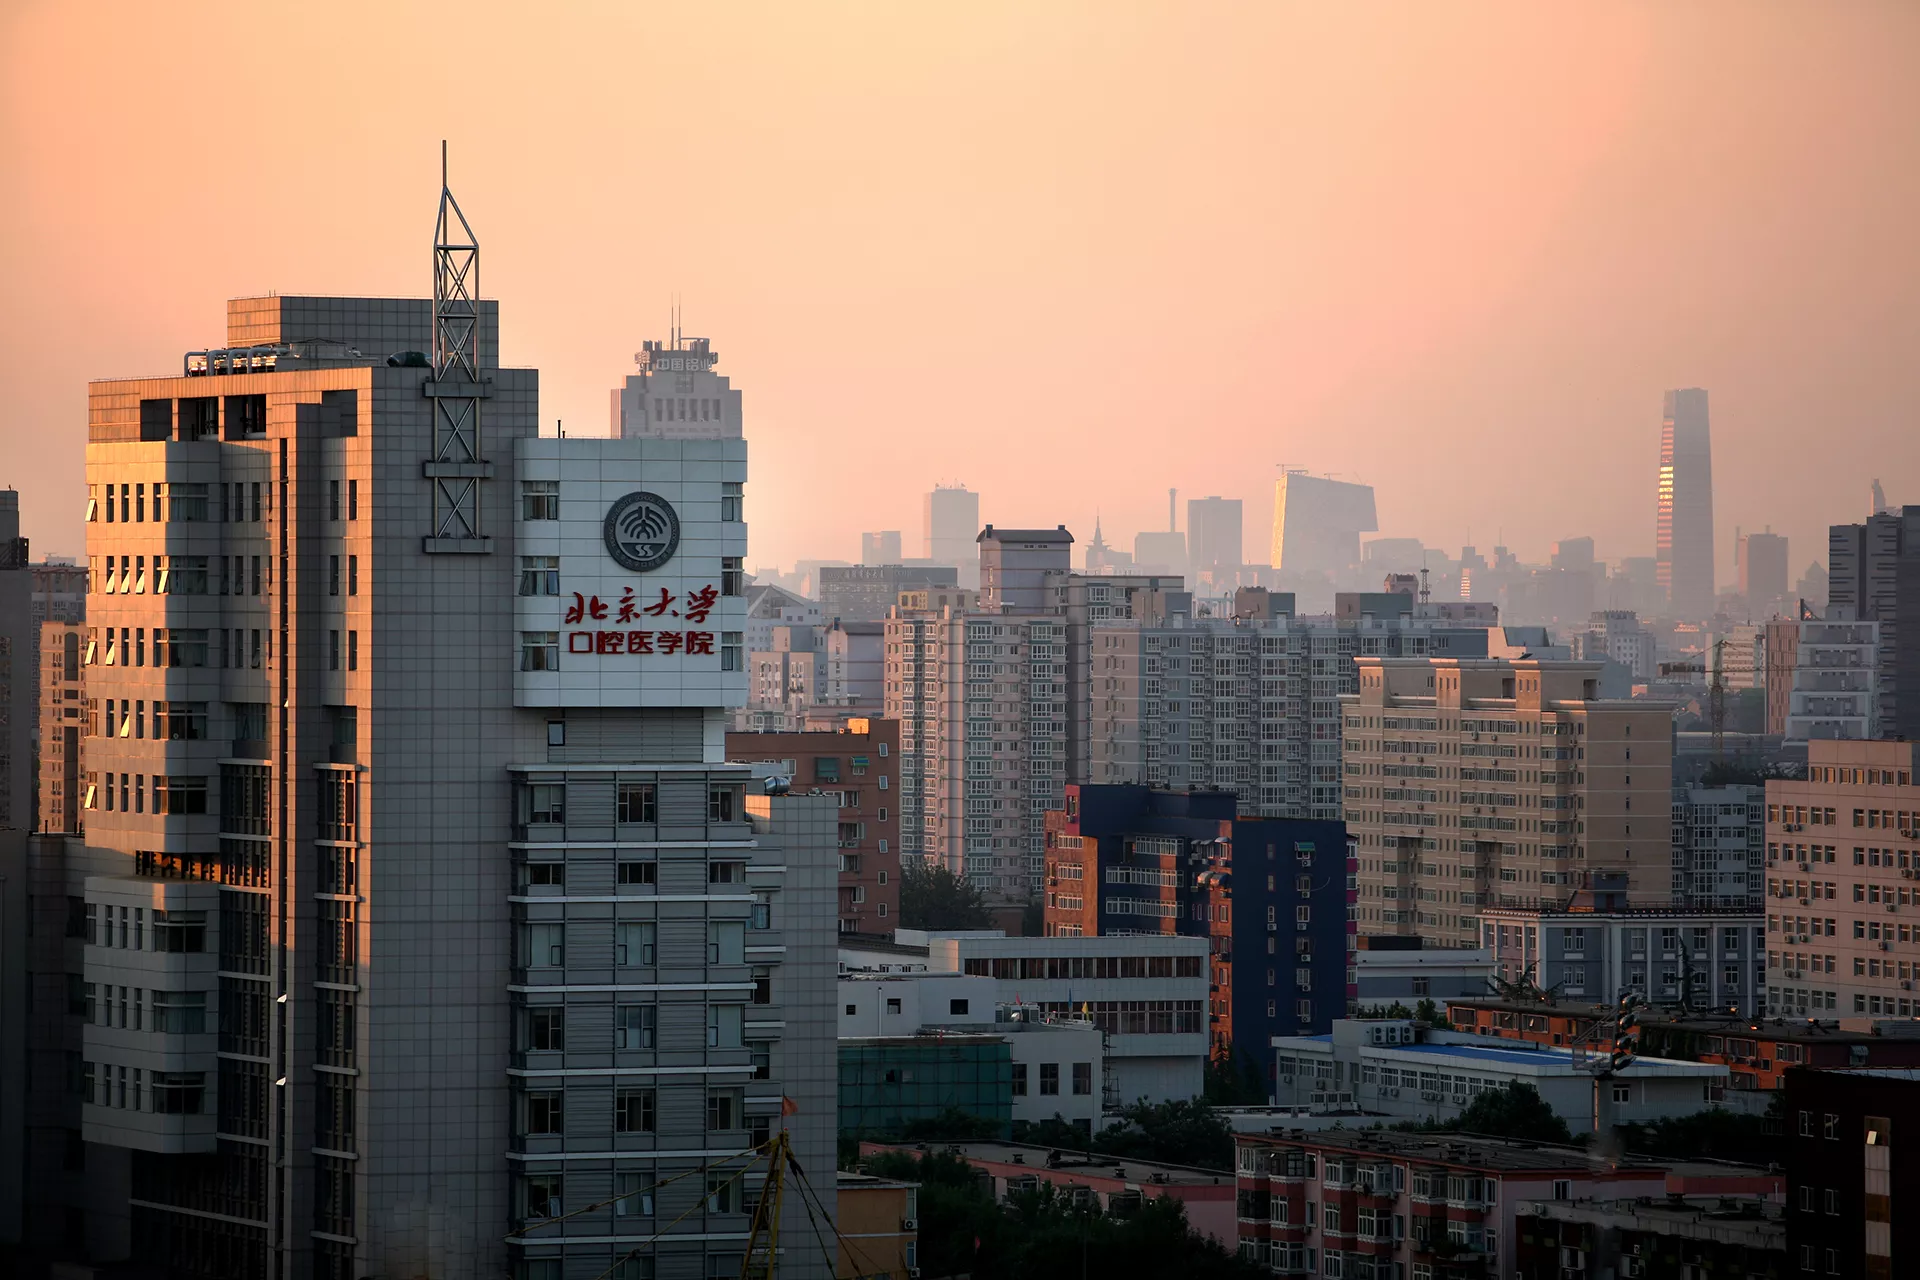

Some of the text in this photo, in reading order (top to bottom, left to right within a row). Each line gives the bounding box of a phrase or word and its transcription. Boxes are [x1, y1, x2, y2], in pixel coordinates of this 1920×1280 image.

[656, 358, 713, 372] 中国铝业
[565, 584, 718, 624] 北京大学
[569, 631, 714, 655] 口腔医学院
